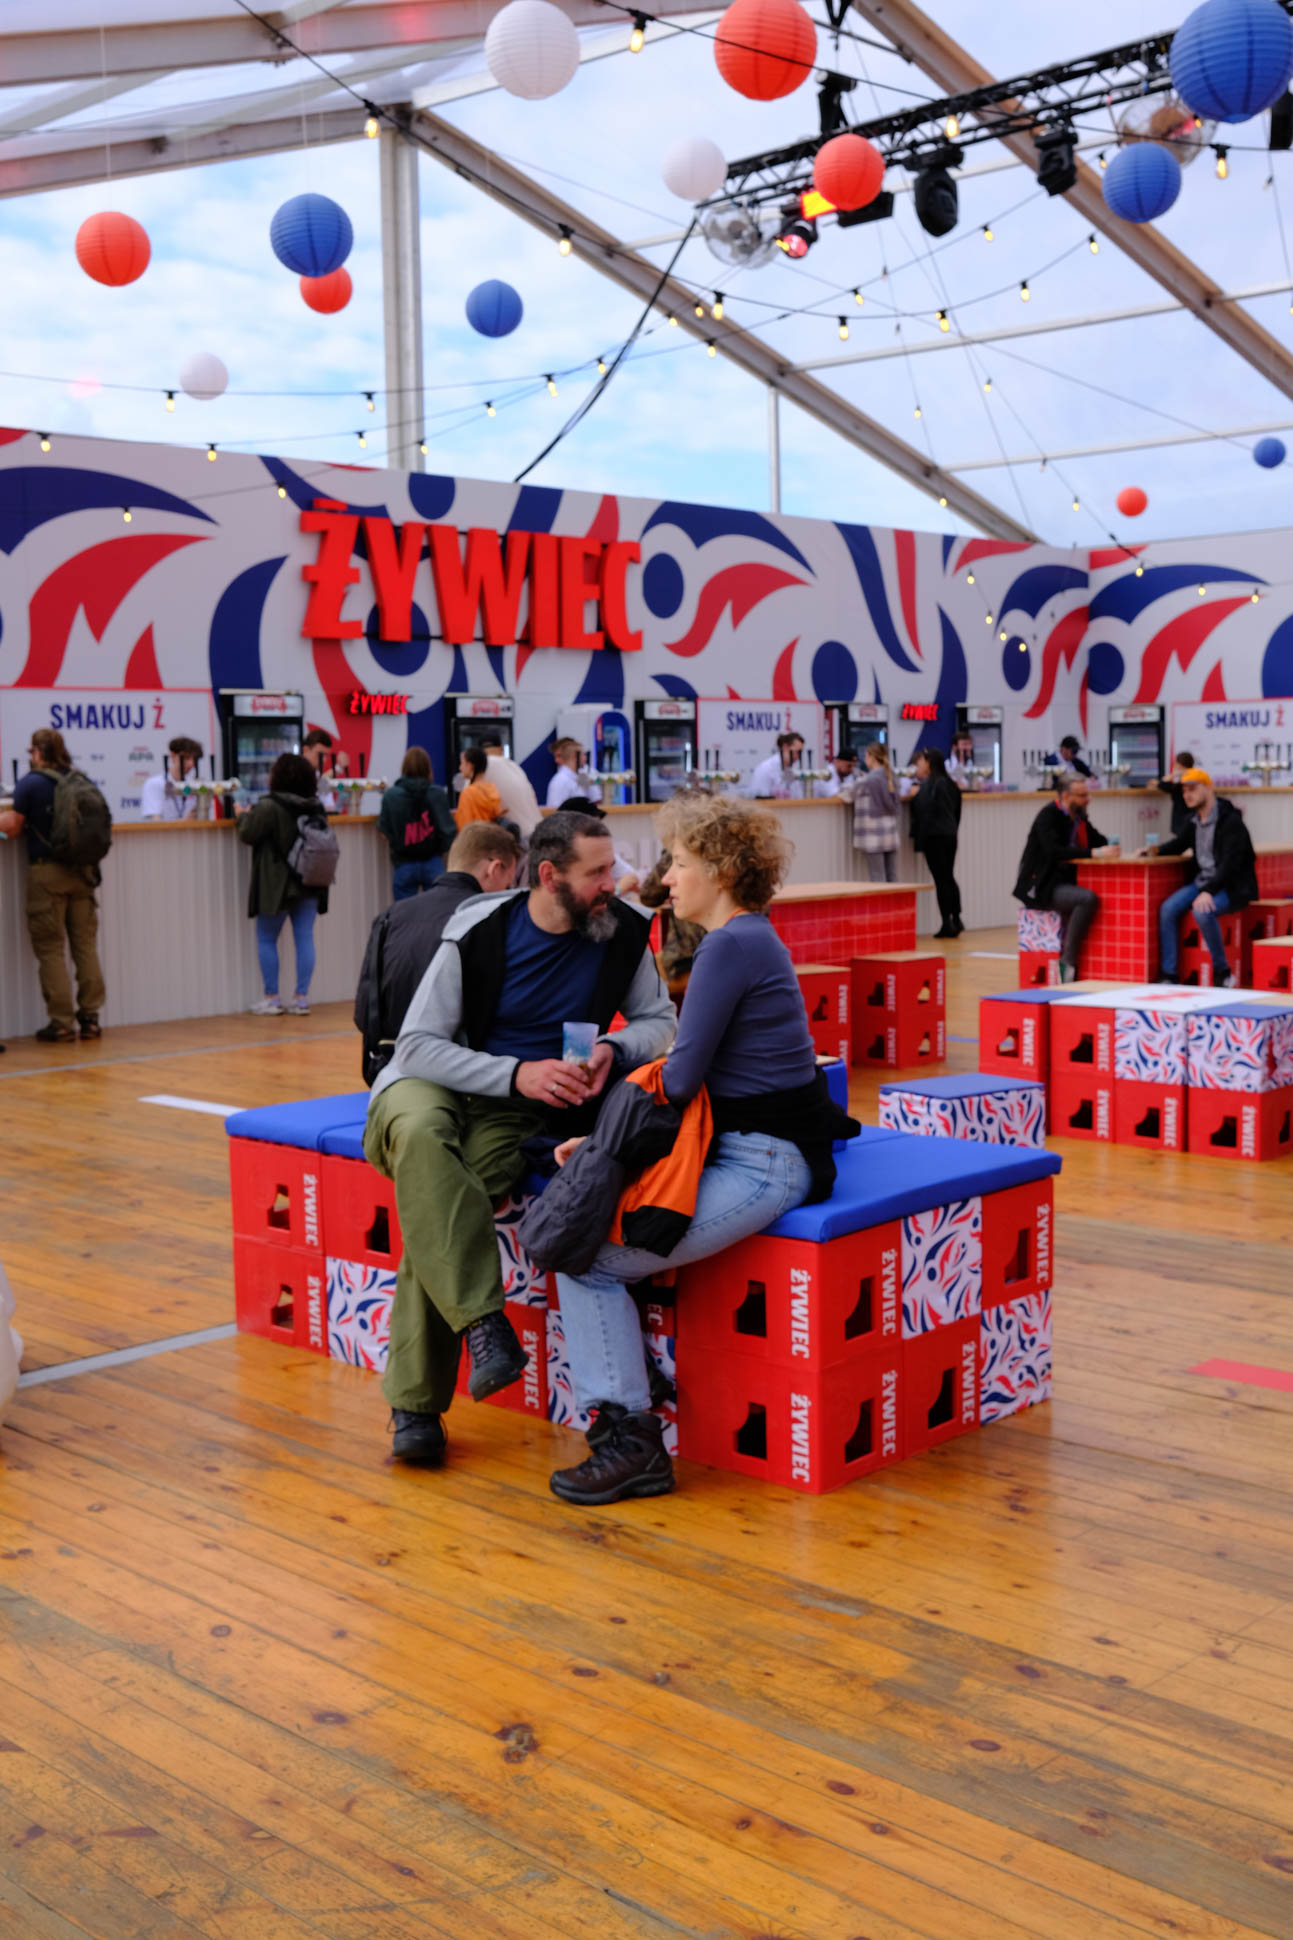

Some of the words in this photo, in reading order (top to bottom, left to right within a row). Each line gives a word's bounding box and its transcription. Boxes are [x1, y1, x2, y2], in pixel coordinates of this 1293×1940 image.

[300, 498, 643, 651] ŻYWIEC
[50, 704, 145, 729] SMAKUJ
[152, 697, 165, 729] Ż
[350, 690, 409, 715] ŻYWIEC
[727, 711, 781, 731] SMAKUJ
[1205, 710, 1271, 729] SMAKUJ
[304, 1173, 318, 1247] ŻYWIEC
[1037, 1203, 1050, 1285] ŻYWIEC
[307, 1276, 322, 1348] ŻYWIEC
[791, 1268, 811, 1358] ŻYWIEC
[882, 1248, 897, 1336] ŻYWIEC
[523, 1329, 540, 1409] ŻYWIEC
[962, 1341, 976, 1424] ŻYWIEC
[791, 1392, 811, 1483] ŻYWIEC
[882, 1369, 897, 1457] ŻYWIEC
